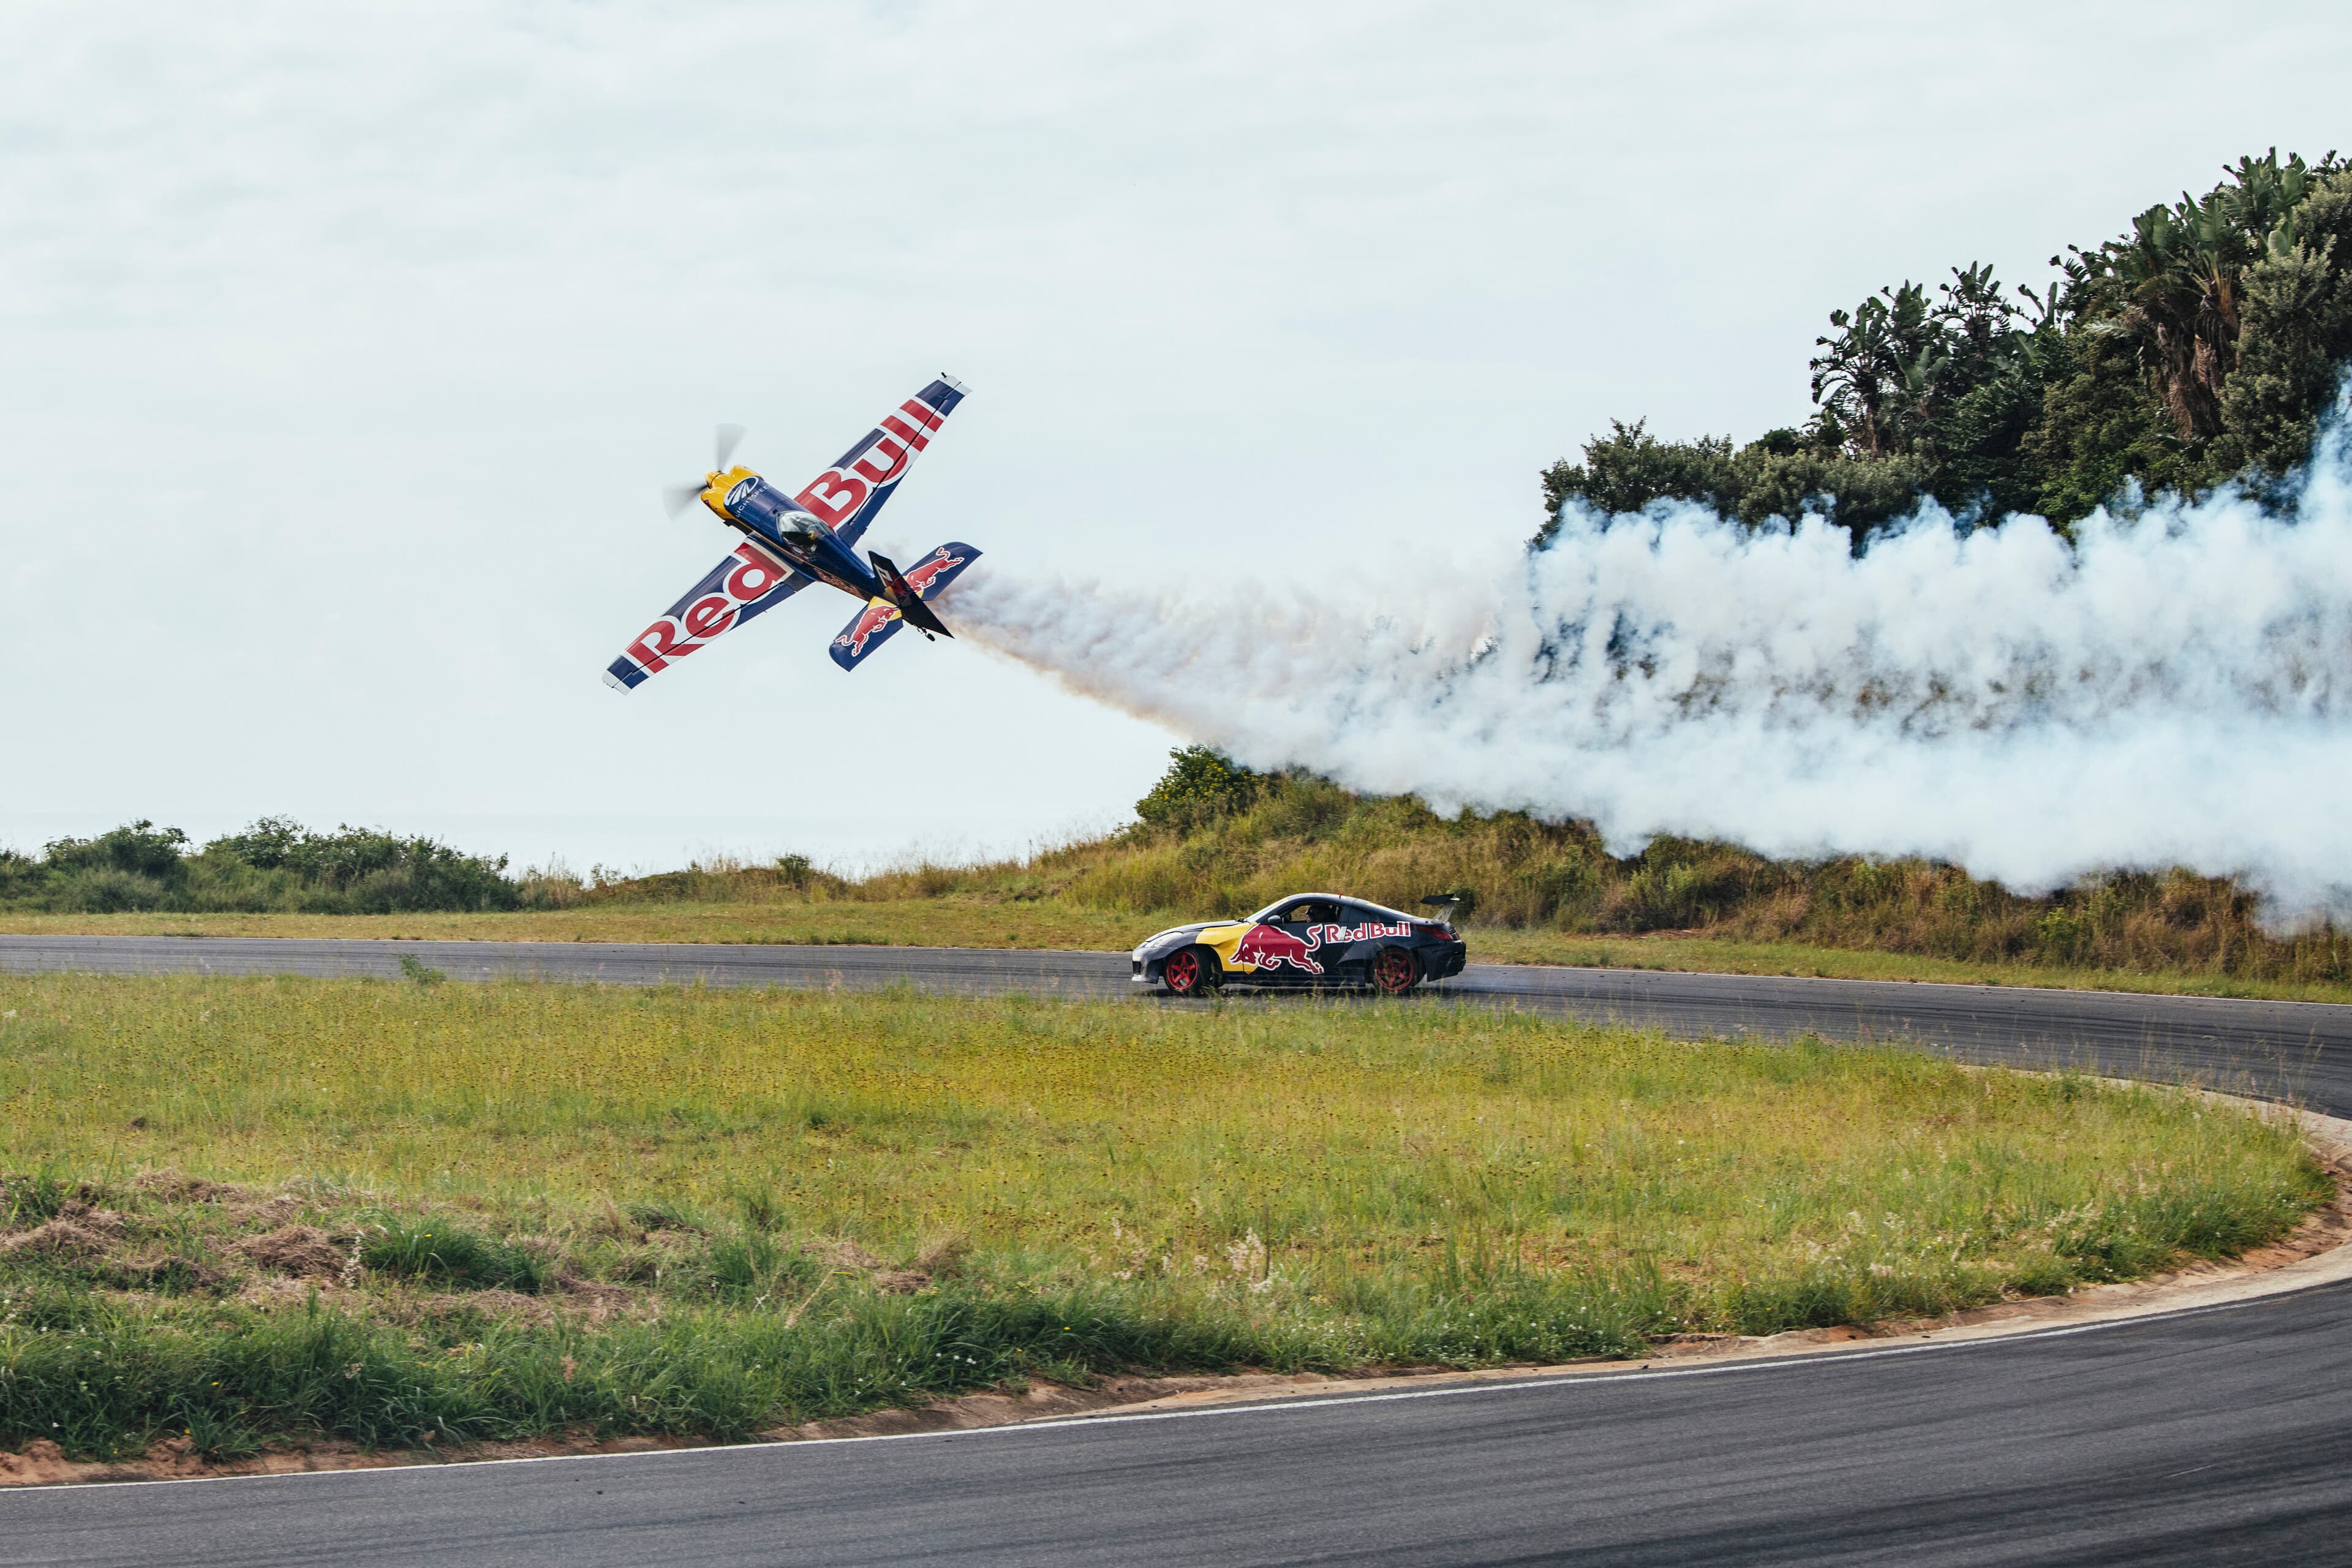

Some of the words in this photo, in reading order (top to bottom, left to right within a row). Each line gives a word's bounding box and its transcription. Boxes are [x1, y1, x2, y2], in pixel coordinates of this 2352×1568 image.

[735, 484, 772, 518] LIGHTSPEE
[625, 542, 790, 674] Red
[794, 398, 944, 529] Bull
[1325, 922, 1367, 943] Red
[1370, 922, 1410, 938] Bull
